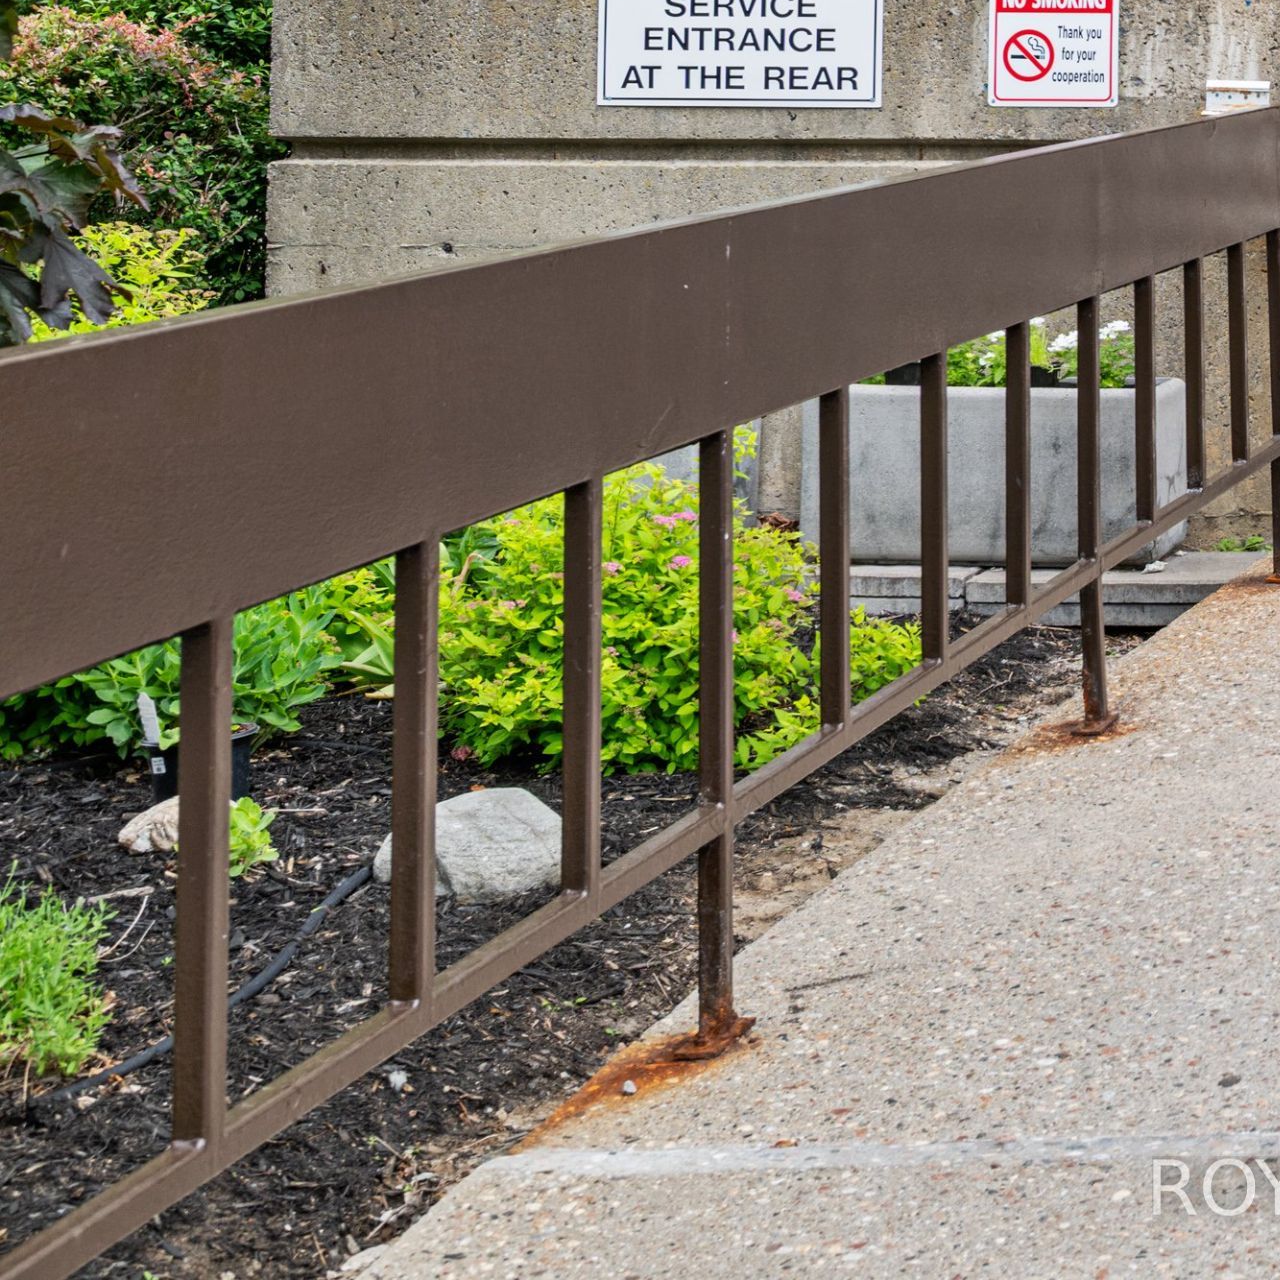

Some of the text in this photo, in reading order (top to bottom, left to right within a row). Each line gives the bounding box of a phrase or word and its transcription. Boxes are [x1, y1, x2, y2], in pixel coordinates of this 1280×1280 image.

[643, 26, 836, 52] ENTRANCE
[1057, 25, 1102, 41] Thank you
[1061, 46, 1097, 63] for your
[620, 65, 859, 91] AT THE REAR
[1051, 69, 1105, 84] cooperation
